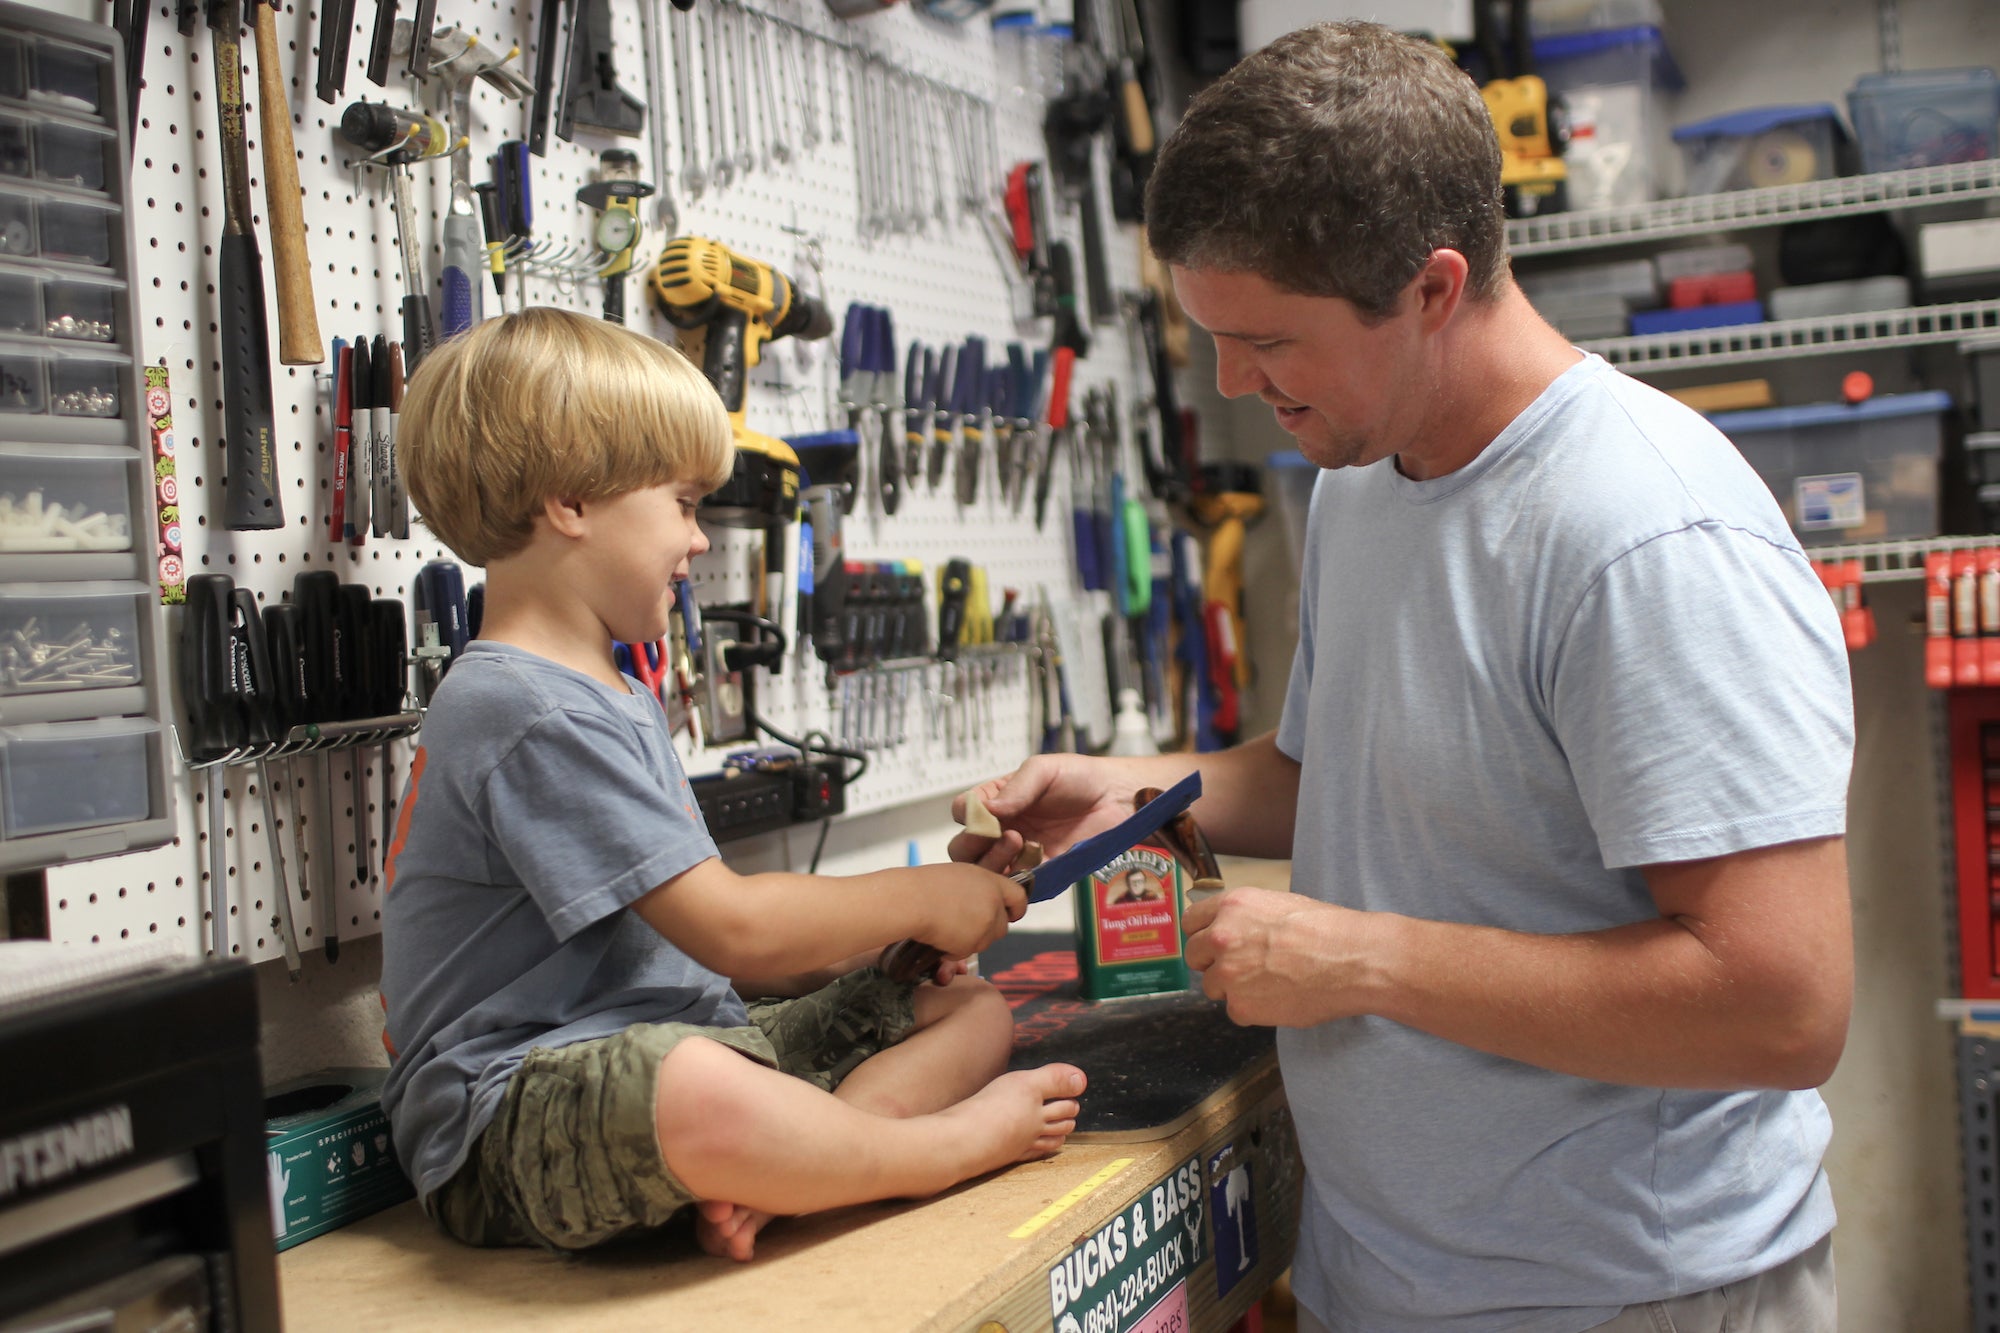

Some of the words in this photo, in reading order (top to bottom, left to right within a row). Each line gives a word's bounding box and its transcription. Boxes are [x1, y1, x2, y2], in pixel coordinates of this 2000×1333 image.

[260, 427, 270, 474] Estwing
[378, 432, 390, 475] Sharpie
[230, 635, 239, 689] Crescent
[240, 641, 255, 694] Crescent
[1101, 918, 1127, 931] Tung
[1127, 914, 1143, 927] Oil
[1143, 911, 1172, 926] Finish
[0, 1103, 134, 1197] FTSMAN
[318, 1116, 387, 1147] SPECIFICATIO
[1050, 1215, 1127, 1318] BUCKS
[1133, 1202, 1148, 1248] &
[1151, 1158, 1201, 1232] BASS
